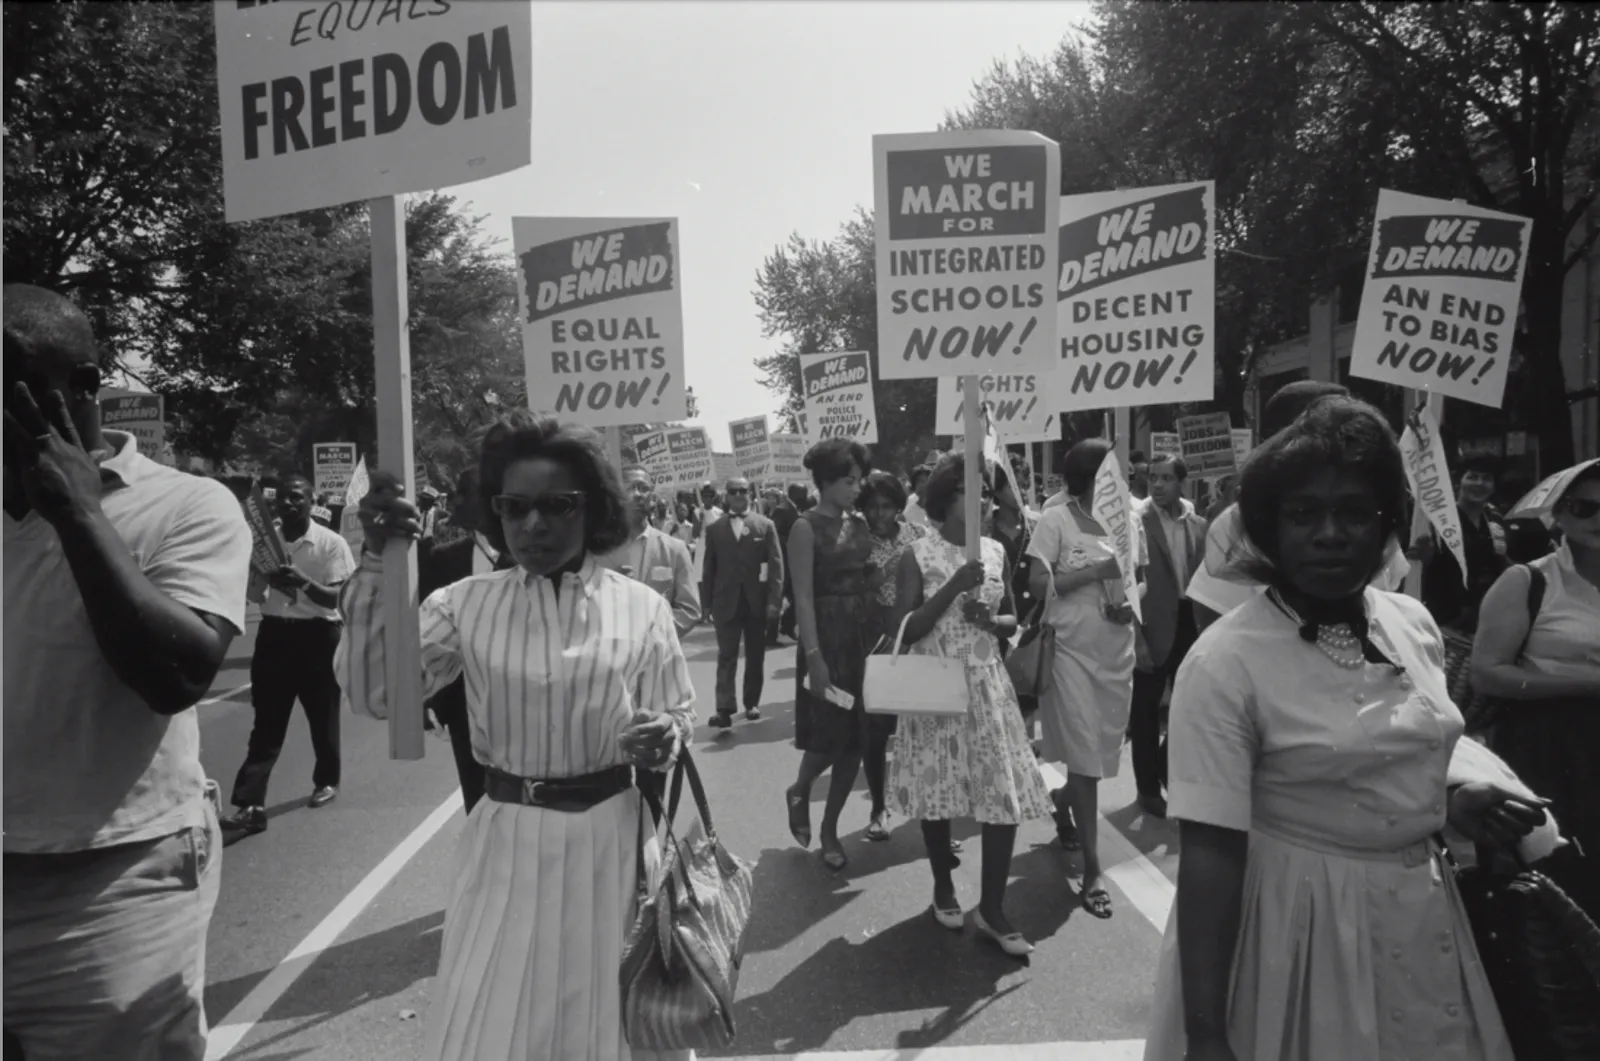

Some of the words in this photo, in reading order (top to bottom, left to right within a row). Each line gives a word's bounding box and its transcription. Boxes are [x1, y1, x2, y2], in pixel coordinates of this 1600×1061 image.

[290, 0, 451, 46] EQUALS
[241, 25, 517, 160] FREEDOM
[944, 154, 992, 178] WE
[900, 181, 1034, 214] MARCH
[943, 217, 994, 232] FOR
[1097, 203, 1155, 246] WE
[1424, 218, 1480, 243] WE
[571, 232, 624, 270] WE
[890, 244, 1046, 276] INTEGRATED
[1058, 222, 1202, 292] DEMAND
[1382, 245, 1516, 272] DEMAND
[536, 254, 668, 311] DEMAND
[891, 282, 1043, 314] SCHOOLS
[1073, 289, 1193, 323] DECENT
[1382, 284, 1430, 311] AN
[1440, 293, 1505, 326] END
[551, 317, 660, 343] EQUAL
[903, 316, 1037, 361] NOW!
[1061, 324, 1204, 359] HOUSING
[1382, 310, 1421, 337] TO
[1430, 319, 1499, 354] BIAS
[551, 346, 666, 374] RIGHTS
[824, 357, 848, 375] WE
[1070, 348, 1197, 394] NOW!
[1376, 340, 1495, 386] NOW!
[555, 372, 671, 413] NOW!
[810, 366, 866, 394] DEMAND
[956, 375, 1036, 392] RGHTS
[119, 396, 142, 409] WE
[816, 394, 835, 404] AN
[838, 393, 863, 402] END
[827, 405, 855, 415] POLICE
[104, 407, 158, 422] DEMAND
[819, 414, 862, 424] BRUTALITY
[672, 437, 703, 449] MARCH
[820, 419, 870, 439] NOW!
[319, 452, 351, 461] MARCH
[679, 466, 710, 482] NOW!
